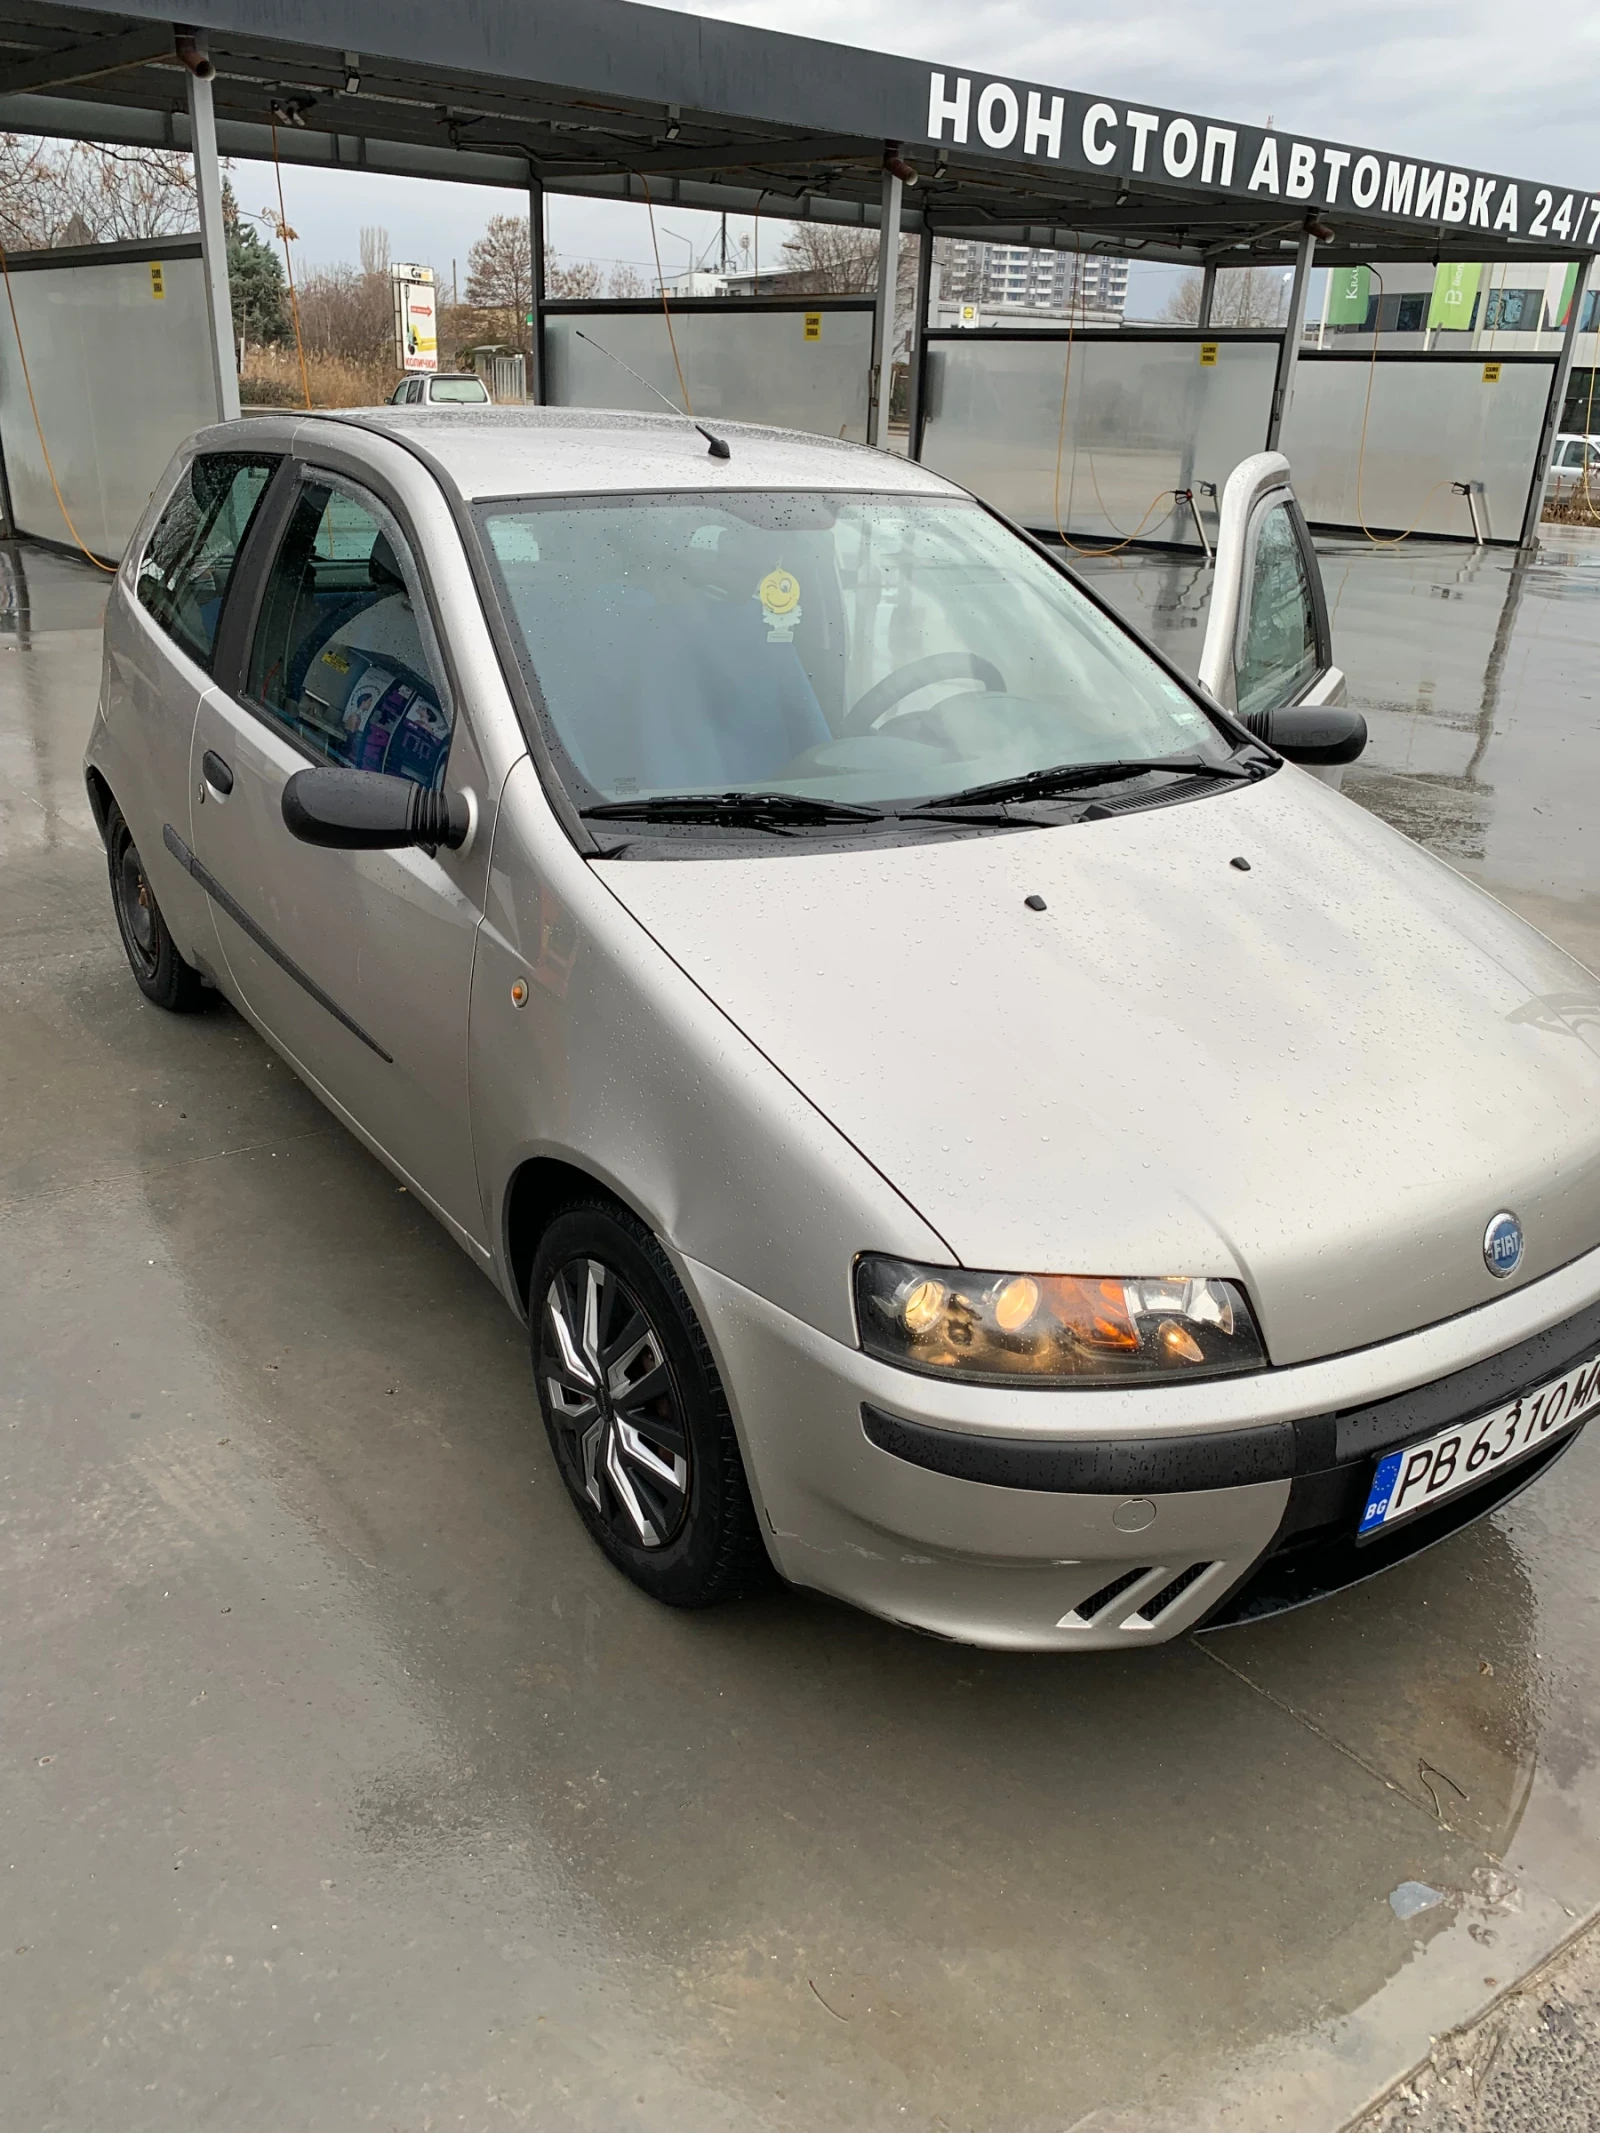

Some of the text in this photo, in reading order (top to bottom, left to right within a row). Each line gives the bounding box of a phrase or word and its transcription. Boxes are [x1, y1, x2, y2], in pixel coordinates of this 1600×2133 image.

[927, 72, 1600, 246] НОН СТОП АВТОМИВКА 24/7
[1493, 1231, 1519, 1260] FIAT
[1365, 1499, 1388, 1520] BG
